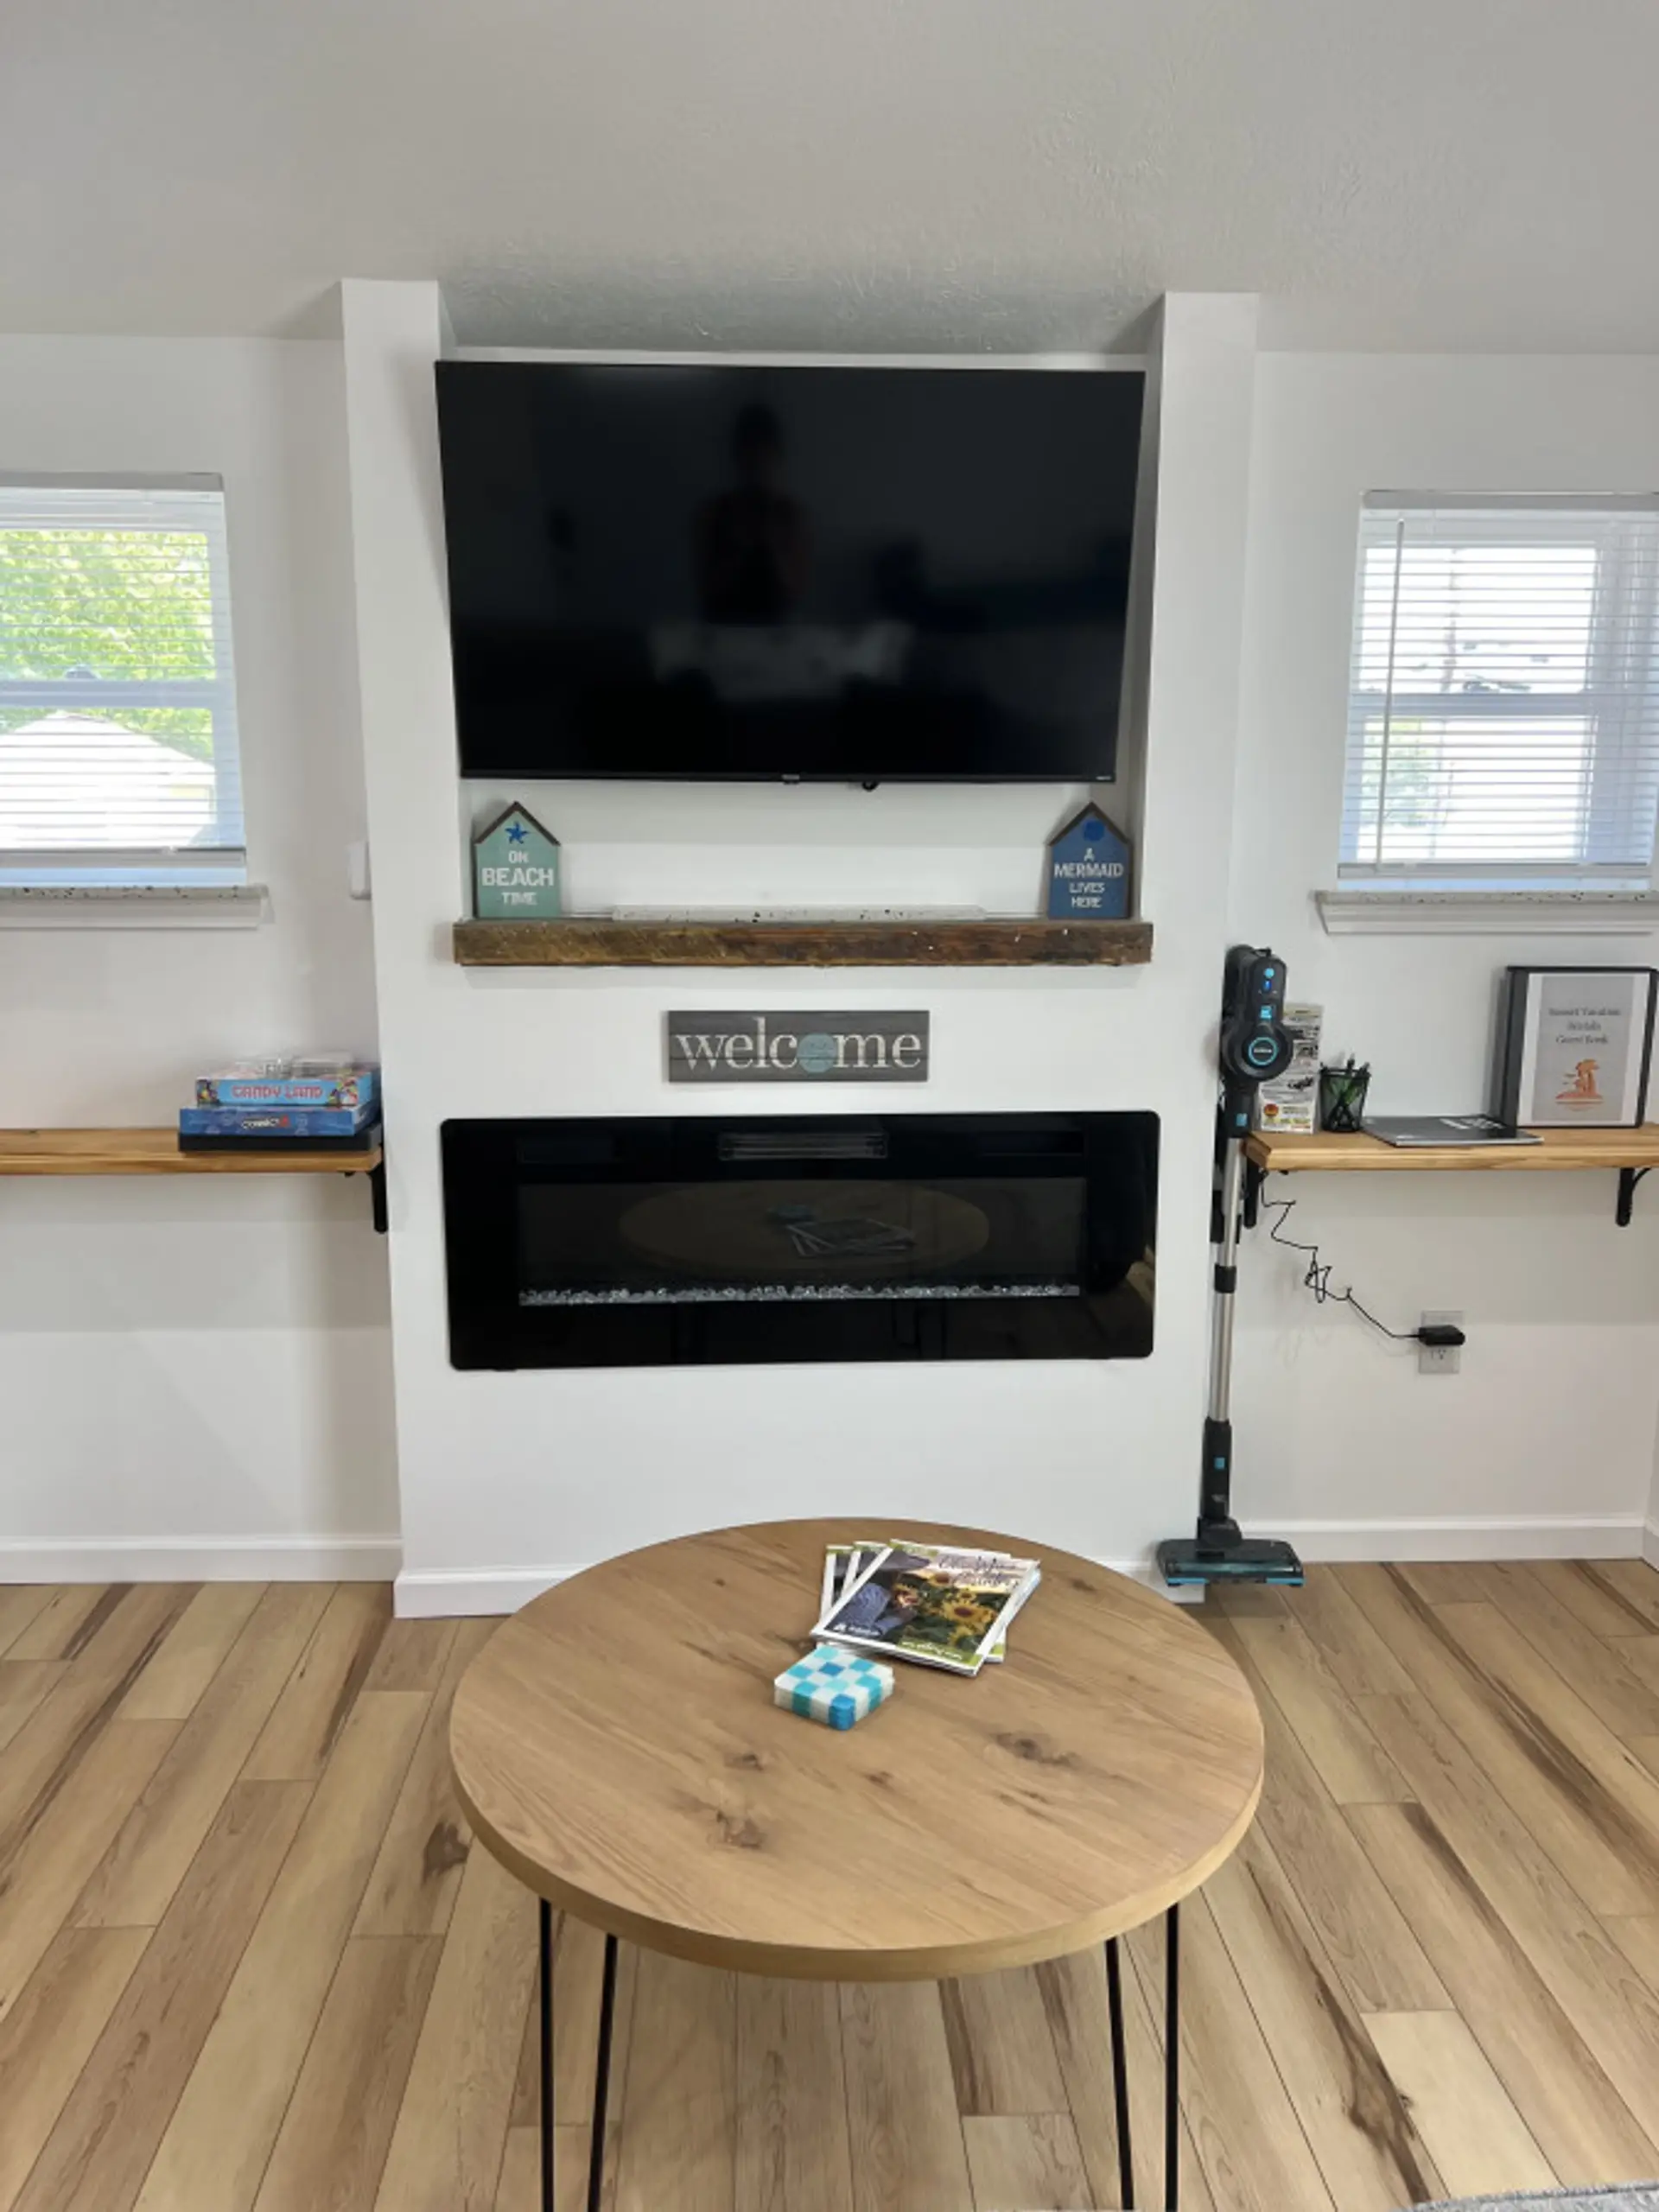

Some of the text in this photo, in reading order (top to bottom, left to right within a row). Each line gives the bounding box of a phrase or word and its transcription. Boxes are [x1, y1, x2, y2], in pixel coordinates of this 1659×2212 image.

[508, 850, 529, 863] ON
[1084, 847, 1096, 861] A
[481, 867, 555, 887] BEACH
[1054, 862, 1124, 879] MERMAID
[1069, 881, 1105, 893] LIVES
[501, 892, 537, 906] TIME
[1071, 896, 1103, 908] HERE
[232, 1086, 323, 1099] CANDY LAND
